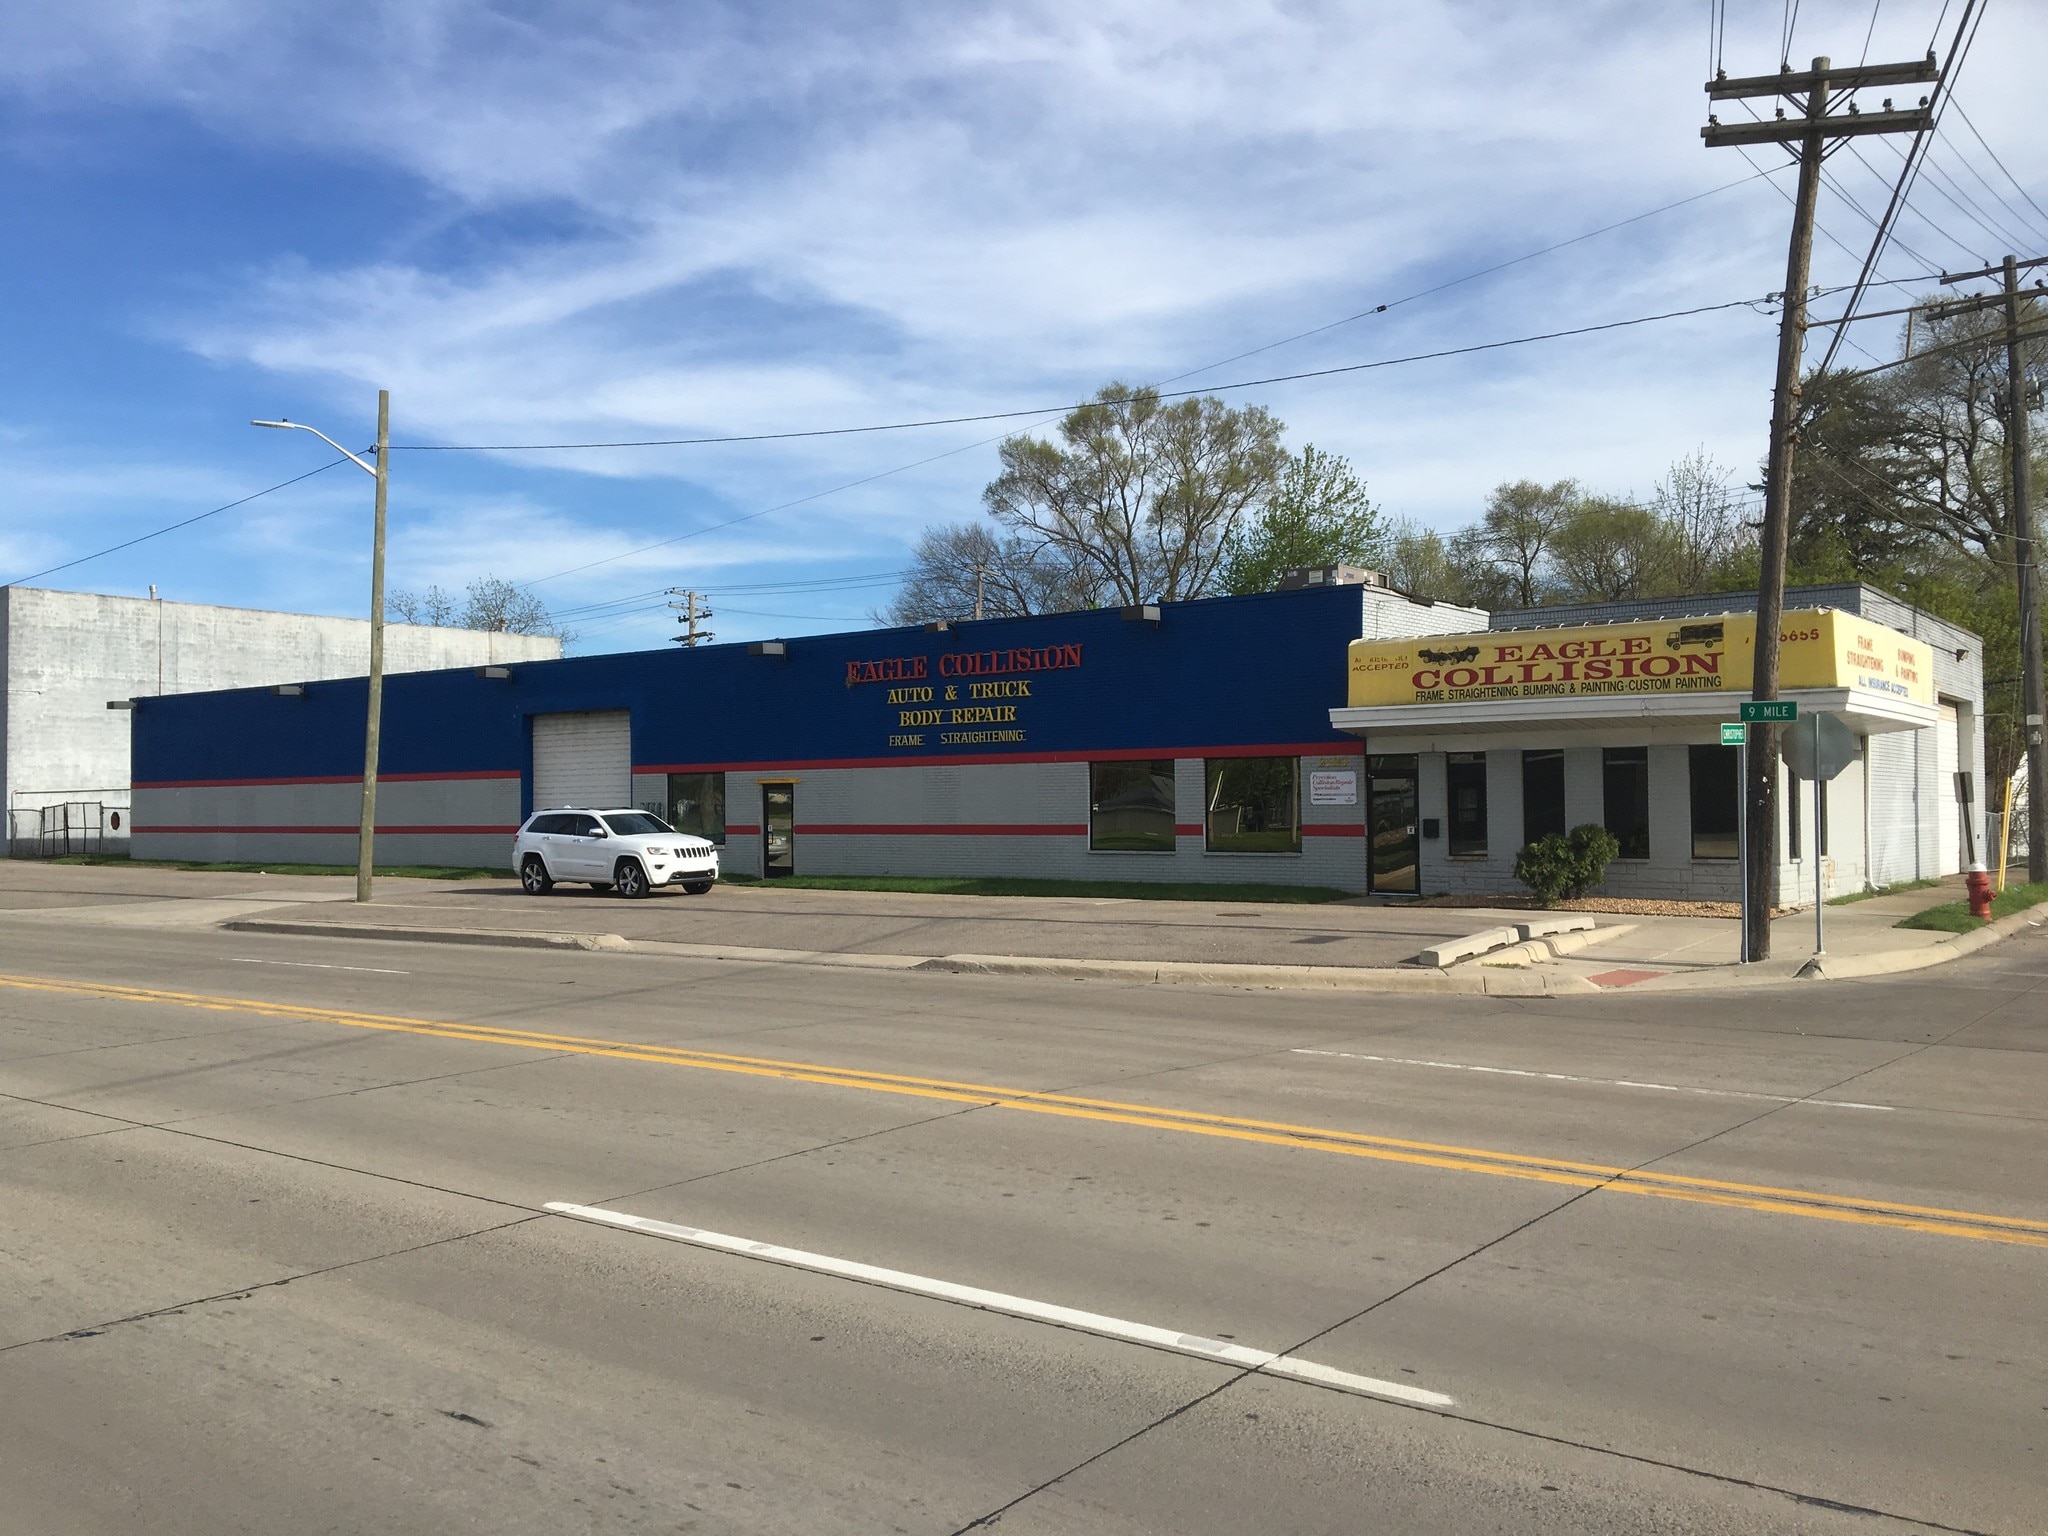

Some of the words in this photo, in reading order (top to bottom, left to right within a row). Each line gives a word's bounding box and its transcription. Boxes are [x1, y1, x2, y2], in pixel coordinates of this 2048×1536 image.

[1493, 636, 1653, 663] EAGLE
[846, 656, 928, 683] EAGLE
[938, 643, 1084, 678] COLLISION
[1352, 662, 1409, 672] ACCEPTED
[1412, 652, 1725, 690] COLLISION
[887, 686, 934, 704] AUTO
[945, 685, 958, 701] &
[969, 680, 1032, 699] TRUCK
[1415, 690, 1445, 701] FRAME
[1448, 686, 1519, 700] STRAIGHTENING
[1523, 683, 1565, 696] BUMPING
[1569, 683, 1577, 693] &
[1675, 675, 1722, 689] PAINTING
[899, 709, 944, 727] BODY
[951, 706, 1017, 724] REPAIR
[1748, 706, 1756, 717] 9
[1763, 706, 1789, 717] MILE
[889, 734, 925, 747] FRAME
[940, 730, 1026, 745] STRAIGHTENING
